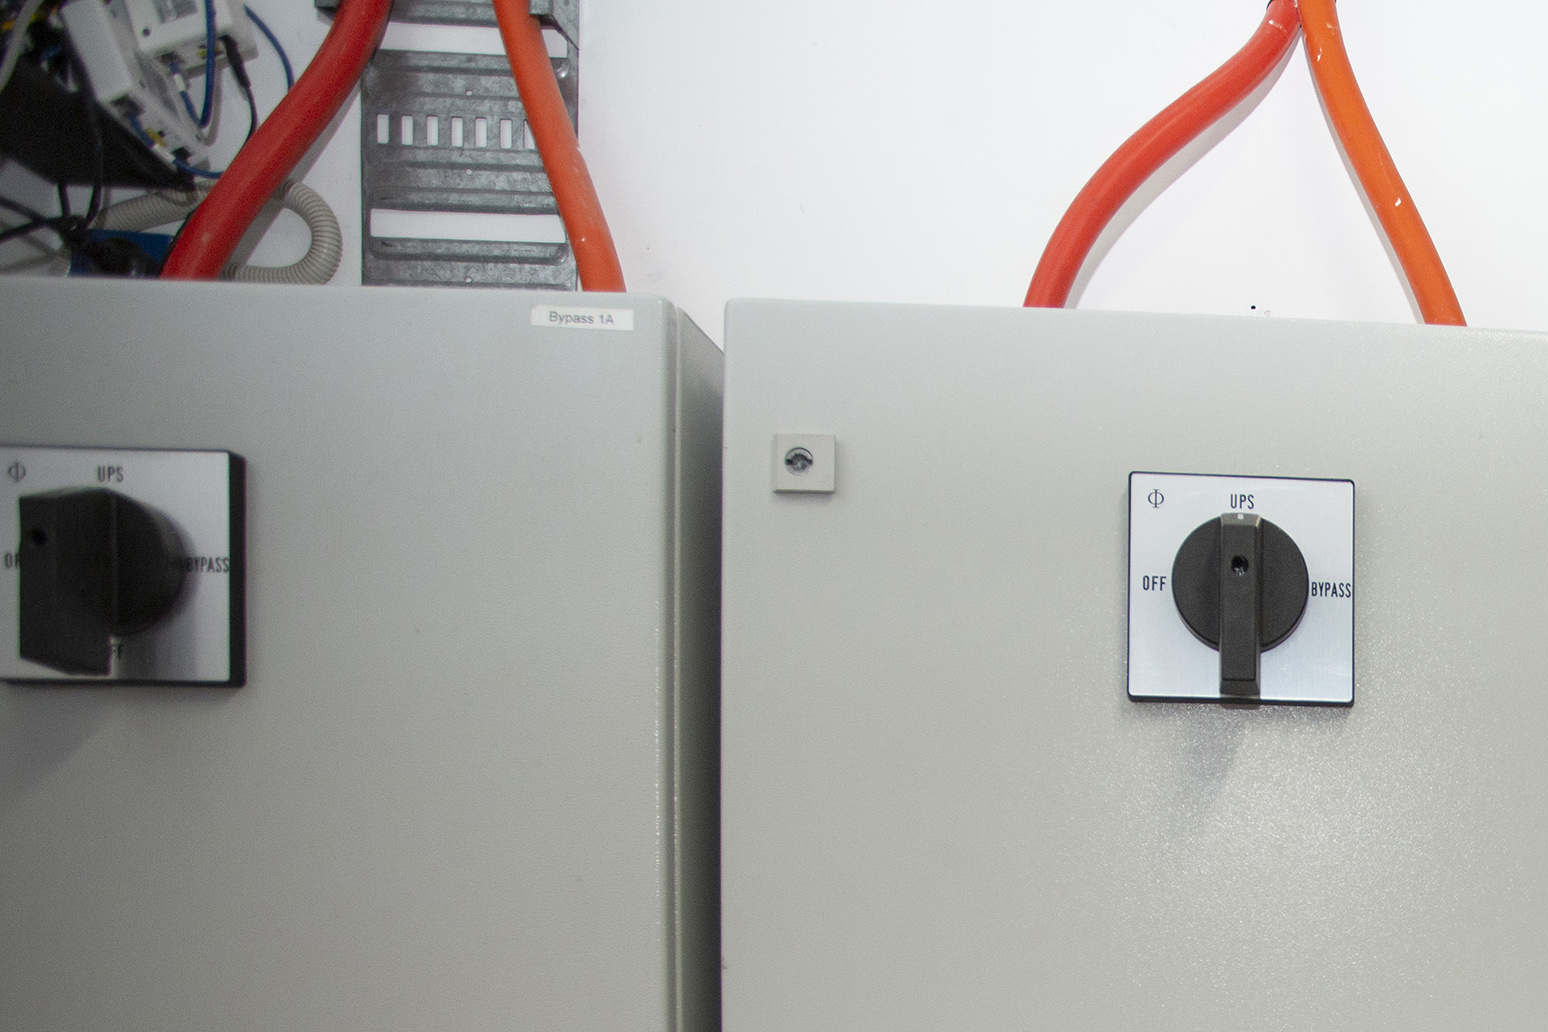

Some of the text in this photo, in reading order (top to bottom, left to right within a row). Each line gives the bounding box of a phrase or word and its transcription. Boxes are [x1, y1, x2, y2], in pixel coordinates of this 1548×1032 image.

[549, 311, 614, 325] Bypass 1A
[97, 466, 124, 483] UPS
[1230, 493, 1255, 510] UPS
[186, 556, 230, 574] BYPASS
[1142, 575, 1167, 591] OFF
[1311, 582, 1352, 598] BYPASS
